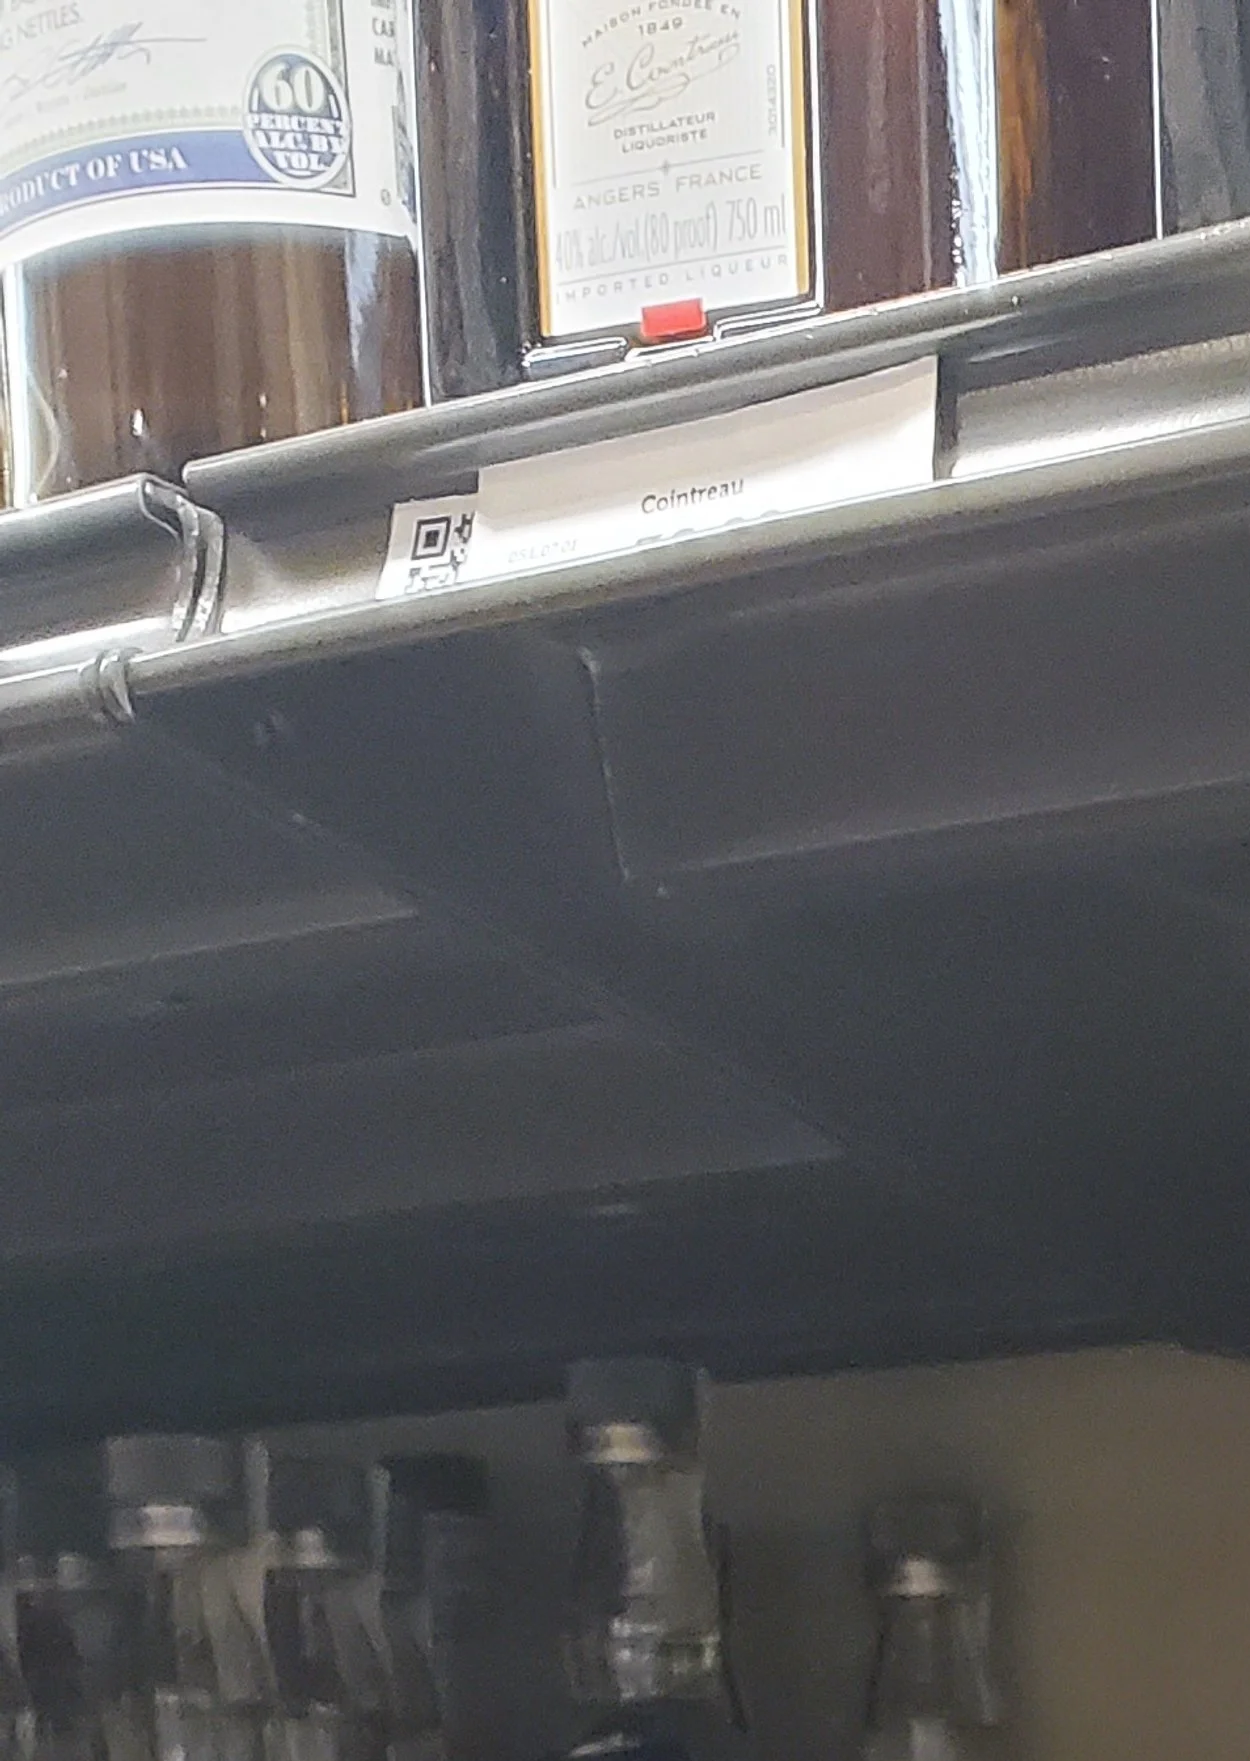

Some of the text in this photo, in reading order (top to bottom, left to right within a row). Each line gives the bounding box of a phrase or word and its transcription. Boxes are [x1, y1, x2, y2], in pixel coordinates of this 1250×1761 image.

[638, 17, 683, 36] 1849
[262, 61, 325, 113] 60
[612, 111, 716, 140] DISTILLATEUR
[622, 130, 709, 153] LIQUORISTE
[86, 154, 123, 180] OF
[129, 147, 188, 174] USA
[573, 163, 764, 210] ANGERS FRANCE
[724, 195, 759, 245] 750
[763, 191, 786, 239] ml
[556, 254, 788, 305] IMPORTED LIQUEUR
[641, 477, 745, 515] Cointreau
